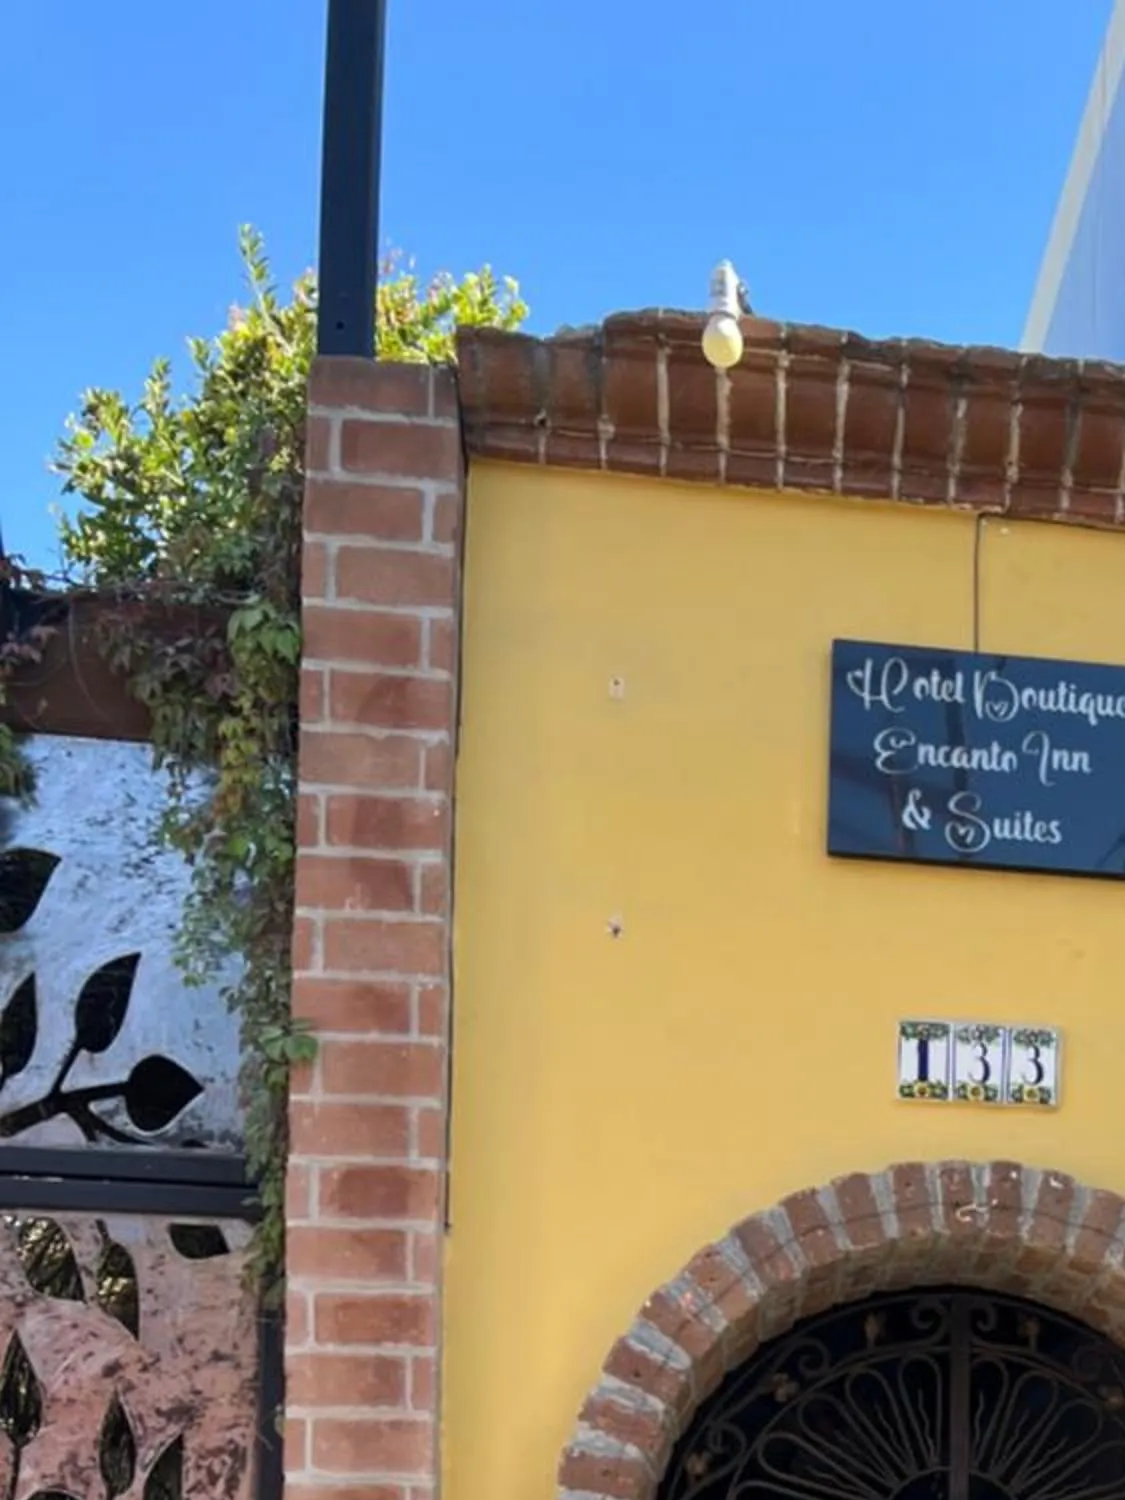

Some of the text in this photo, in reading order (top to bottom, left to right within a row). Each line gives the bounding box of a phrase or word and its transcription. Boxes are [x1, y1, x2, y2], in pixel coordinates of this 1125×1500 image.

[847, 657, 966, 713] Hotel
[873, 726, 1092, 787] Encanto Inn
[902, 789, 1063, 853] & Suites
[917, 1037, 1045, 1086] 133
